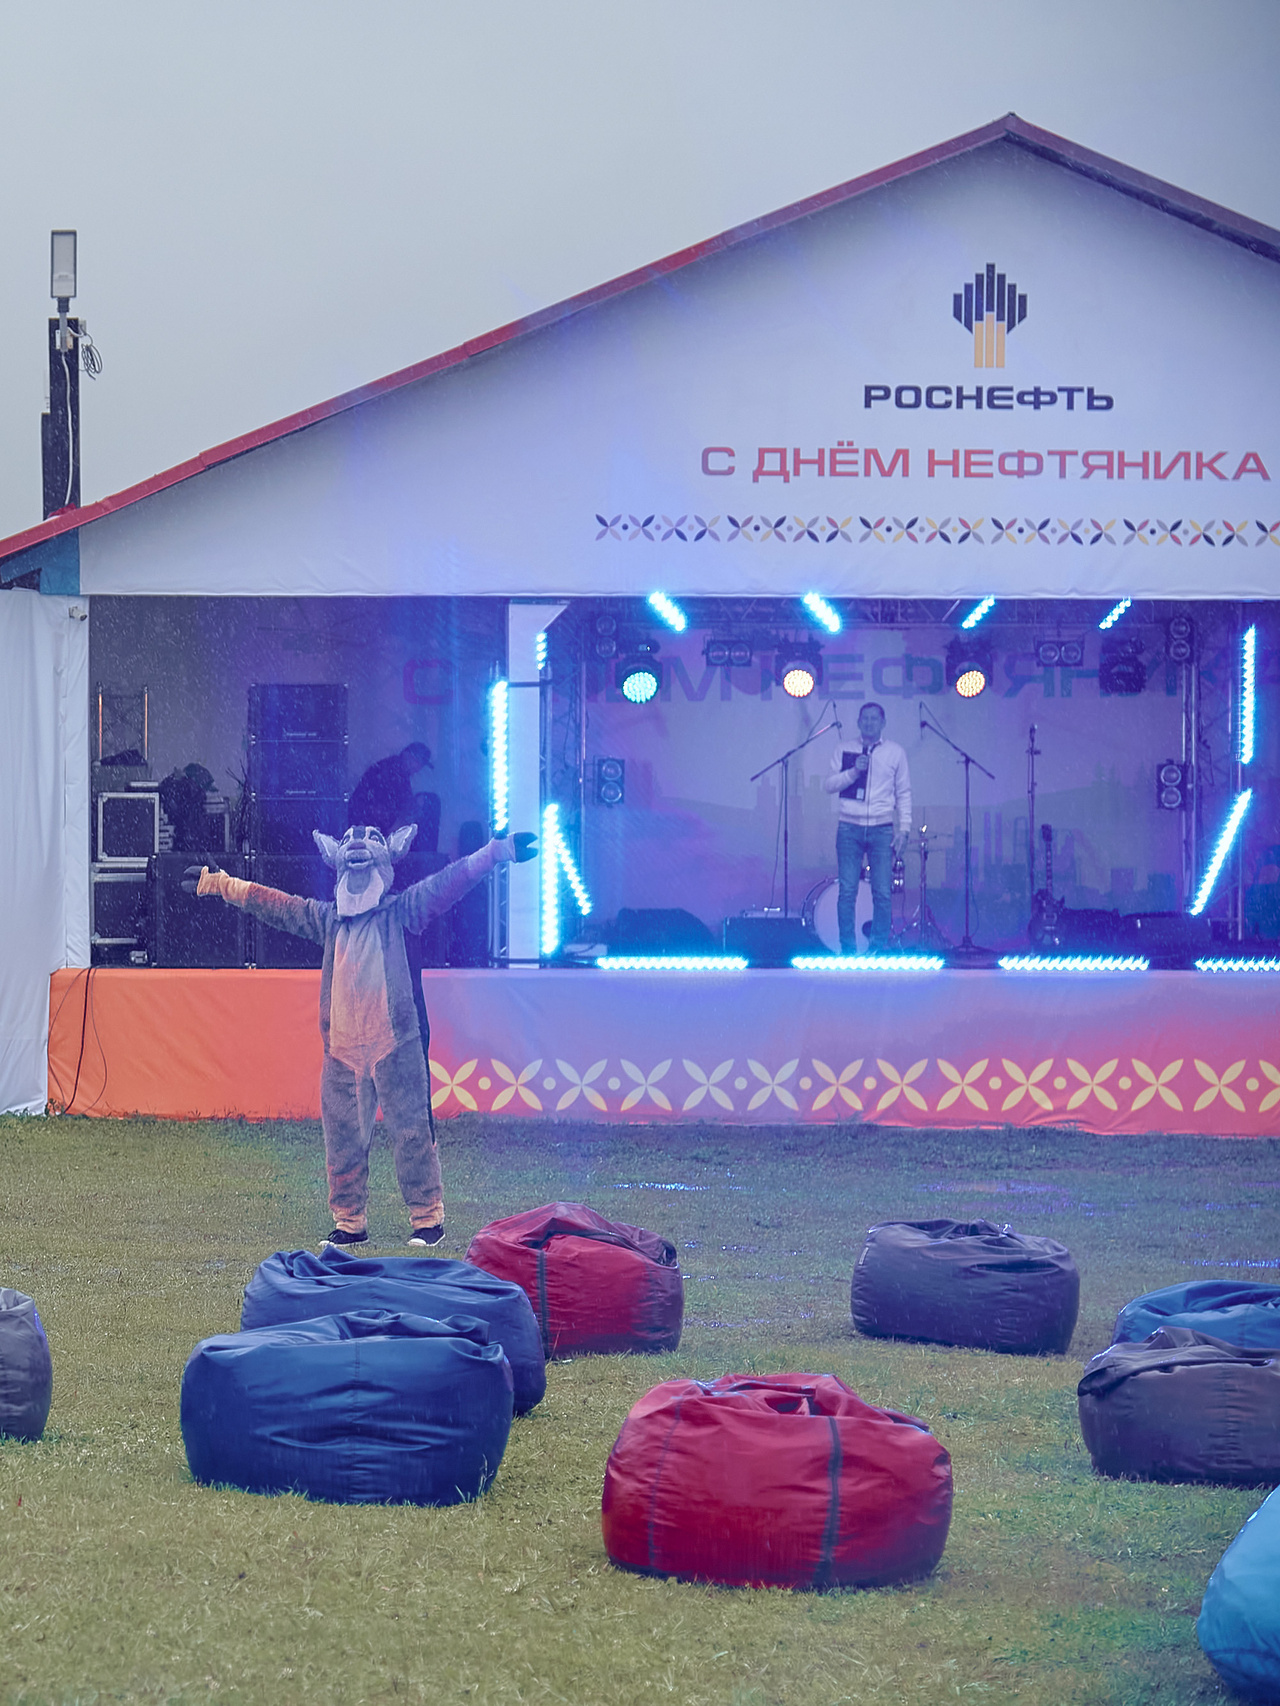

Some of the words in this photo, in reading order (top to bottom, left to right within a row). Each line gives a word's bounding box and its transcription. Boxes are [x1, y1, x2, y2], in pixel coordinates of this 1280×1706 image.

[864, 385, 1115, 412] РОСНЕФТЬ
[701, 447, 735, 476] С
[752, 440, 911, 484] ДНЁМ
[927, 449, 1272, 481] НЕФТЯНИКА
